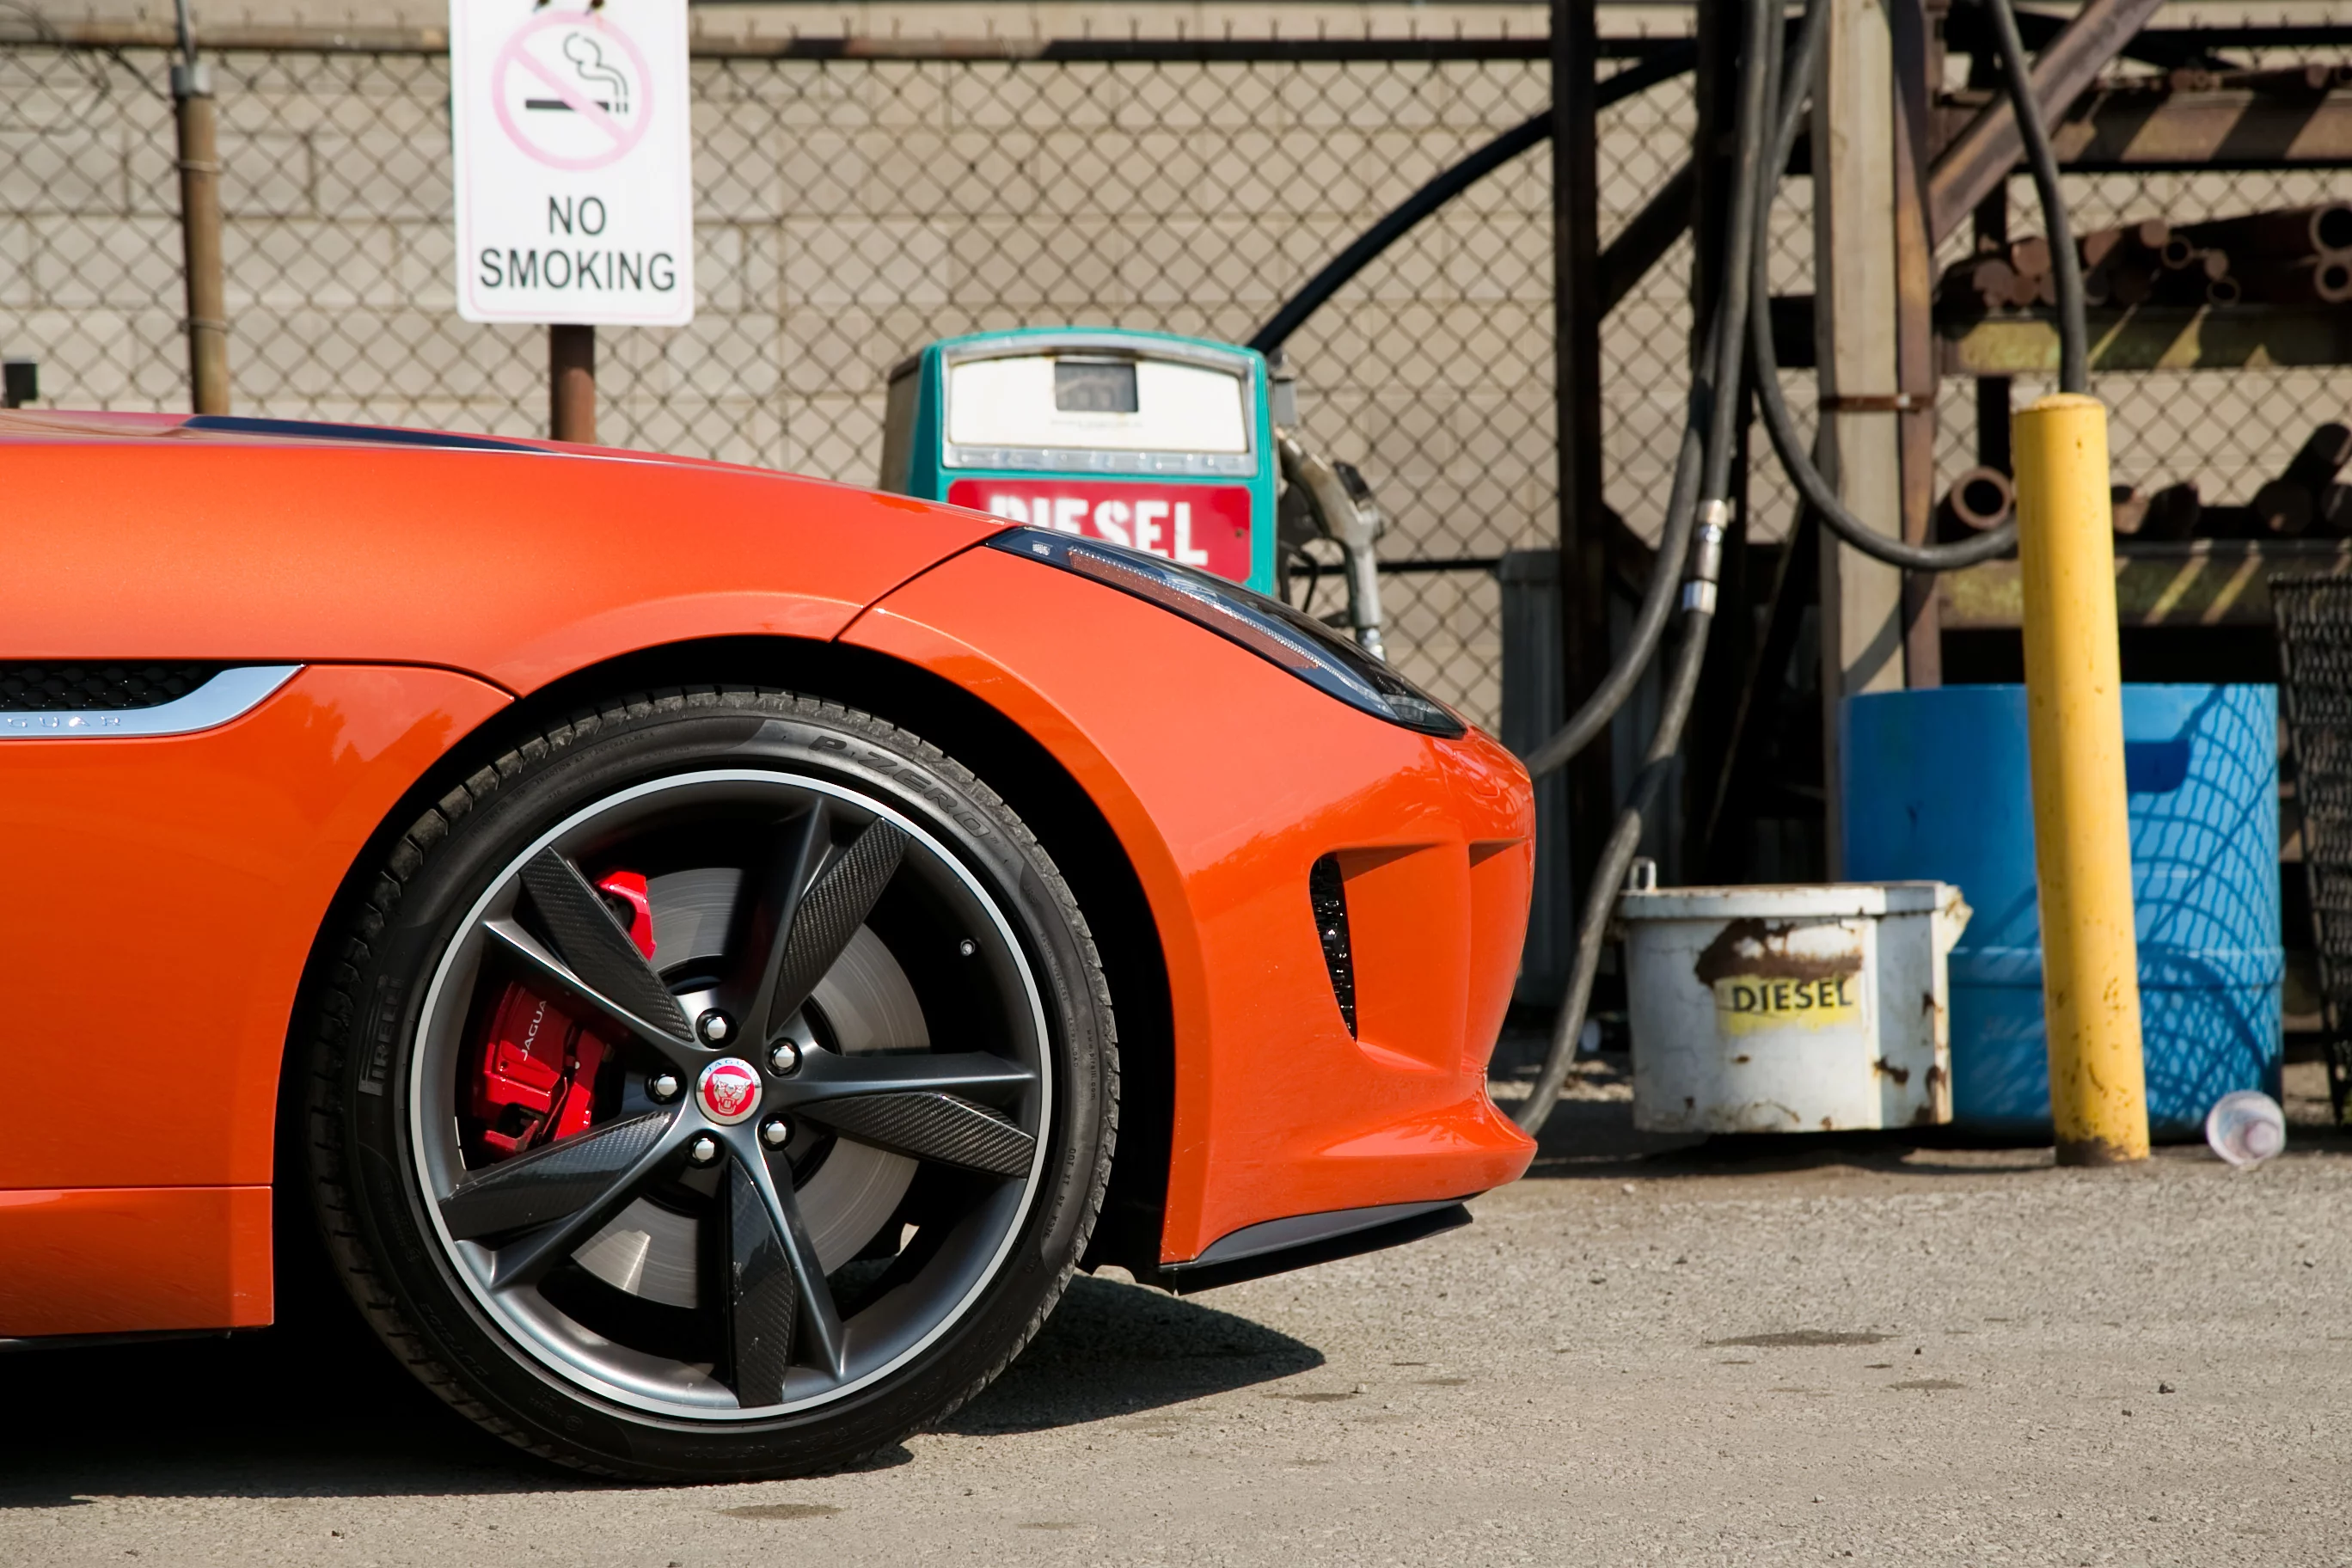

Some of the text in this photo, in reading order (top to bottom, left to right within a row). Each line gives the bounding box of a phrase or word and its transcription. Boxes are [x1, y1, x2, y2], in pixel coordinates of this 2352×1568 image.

[548, 195, 606, 236] NO
[479, 247, 676, 292] SMOKING
[808, 735, 848, 751] P
[857, 750, 991, 838] ZERO
[1730, 978, 1854, 1013] DIESEL
[706, 1058, 760, 1081] JAGUA
[1067, 1148, 1077, 1167] DOT
